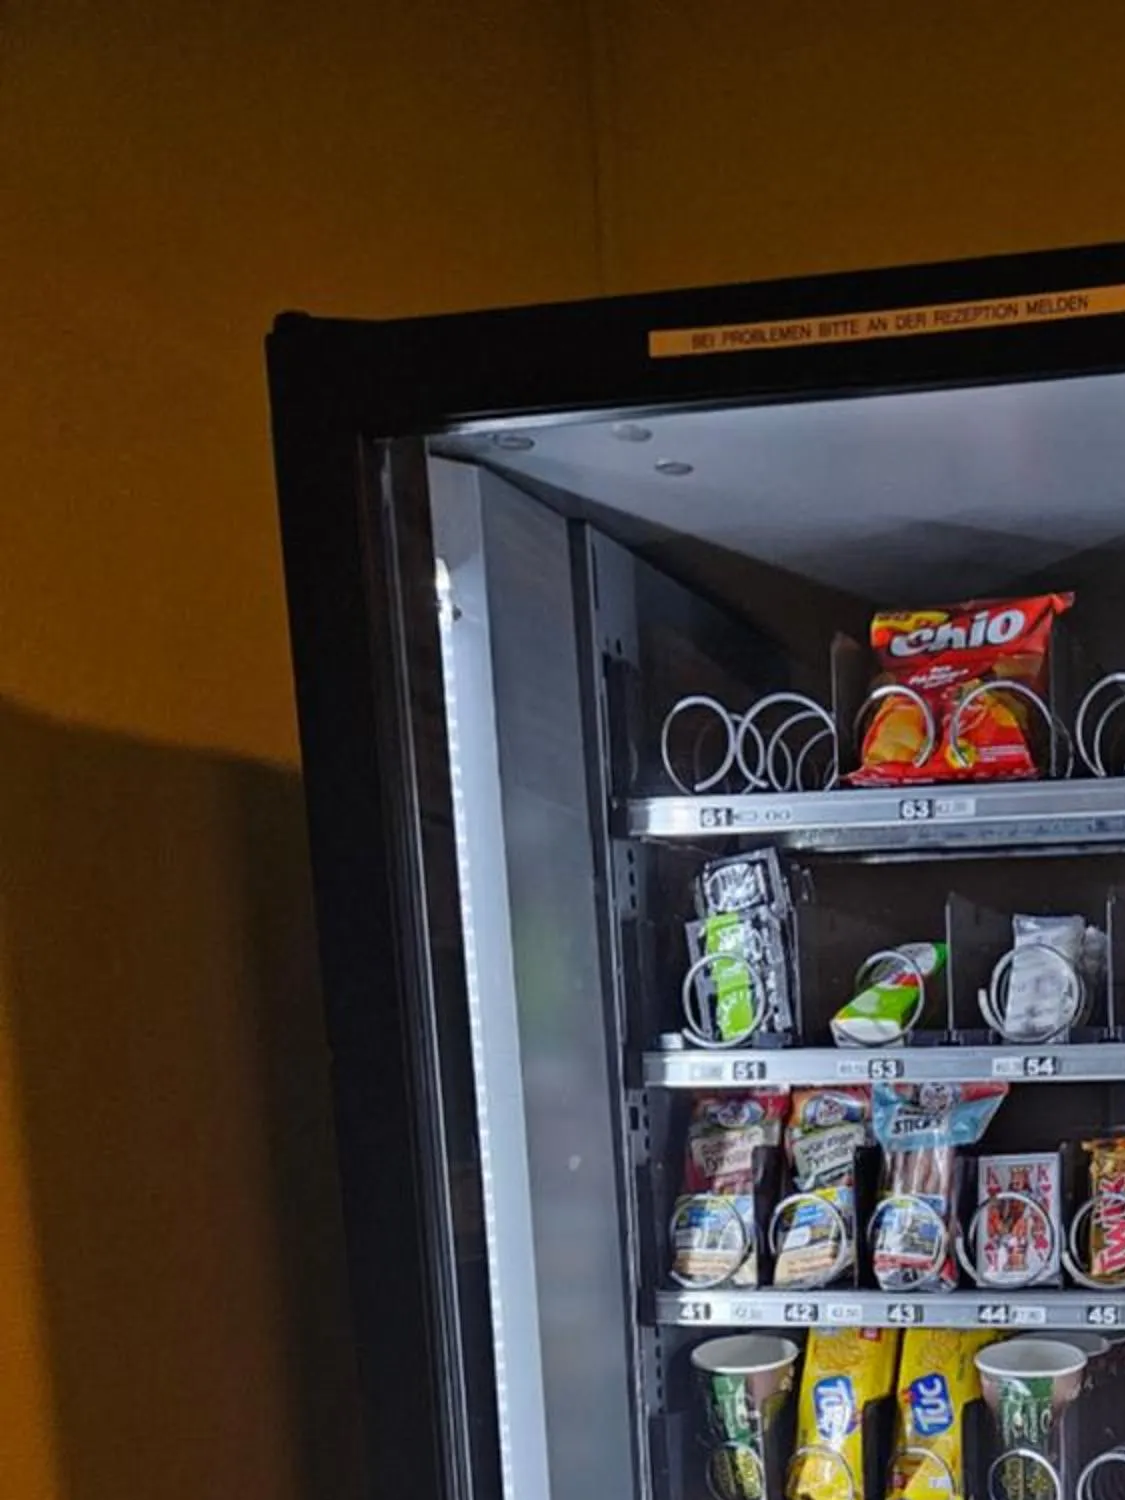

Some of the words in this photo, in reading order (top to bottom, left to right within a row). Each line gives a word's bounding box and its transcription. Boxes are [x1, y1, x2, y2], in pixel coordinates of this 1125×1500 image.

[691, 333, 715, 351] BEI
[722, 323, 812, 348] PROBLEMEN
[818, 319, 859, 338] BITTE
[867, 316, 888, 332] AN
[895, 313, 926, 330] DER
[933, 303, 1019, 326] REZEPTION
[1026, 295, 1089, 314] MELDEN
[890, 609, 1025, 657] Chio
[702, 808, 727, 827] 61
[903, 800, 929, 819] 63
[735, 1061, 759, 1080] 51
[871, 1061, 897, 1079] 53
[1027, 1057, 1053, 1075] 54
[681, 1303, 705, 1320] 41
[788, 1303, 813, 1320] 42
[889, 1305, 915, 1323] 43
[980, 1305, 1006, 1322] 44
[1089, 1307, 1116, 1324] 45
